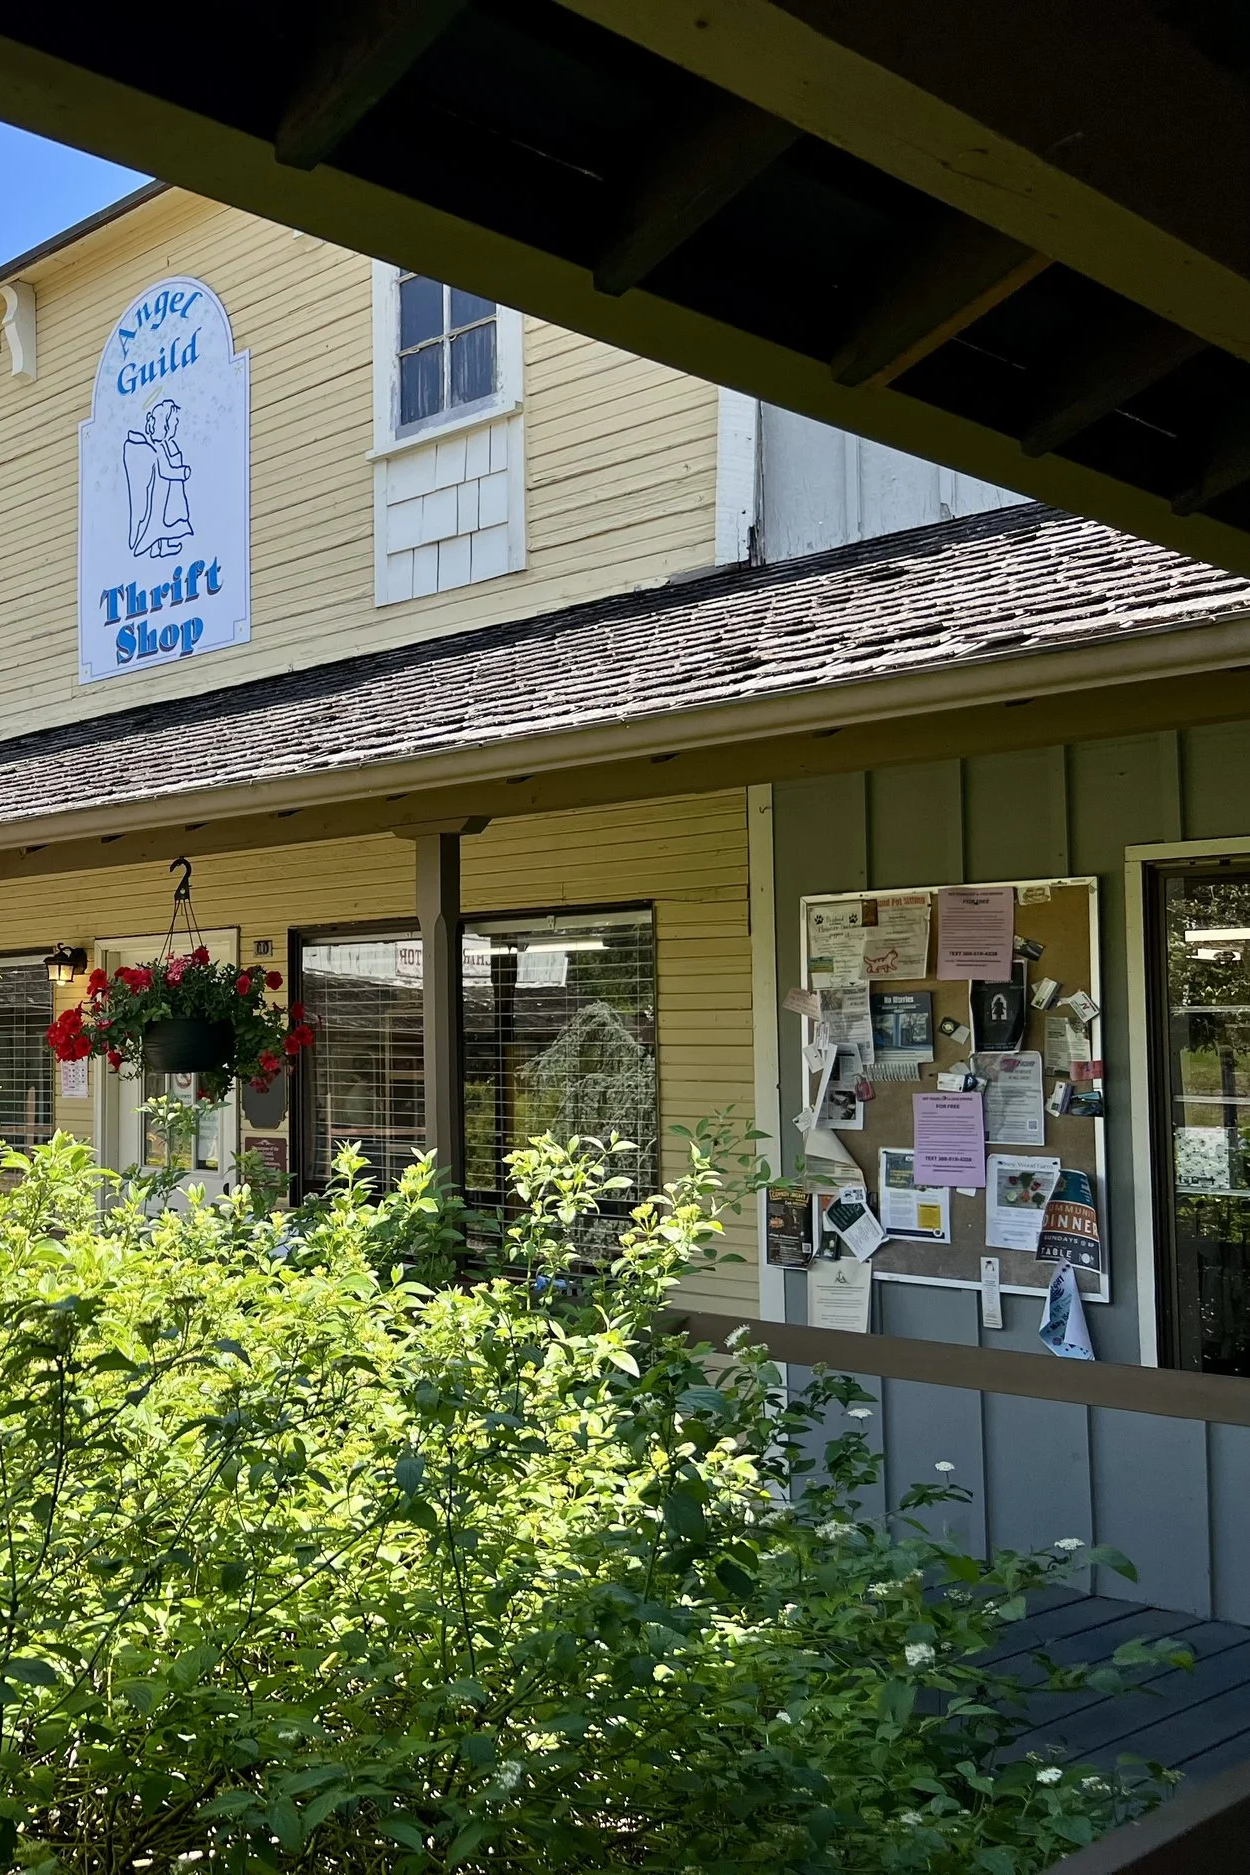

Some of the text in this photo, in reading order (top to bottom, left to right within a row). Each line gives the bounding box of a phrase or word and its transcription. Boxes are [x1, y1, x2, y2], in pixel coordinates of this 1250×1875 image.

[118, 288, 204, 360] Angel
[117, 327, 202, 397] Guild
[99, 556, 224, 627] Thrift
[115, 615, 204, 666] Shop
[1041, 1246, 1073, 1258] TABLE
[1044, 1234, 1079, 1245] SUNDAYS
